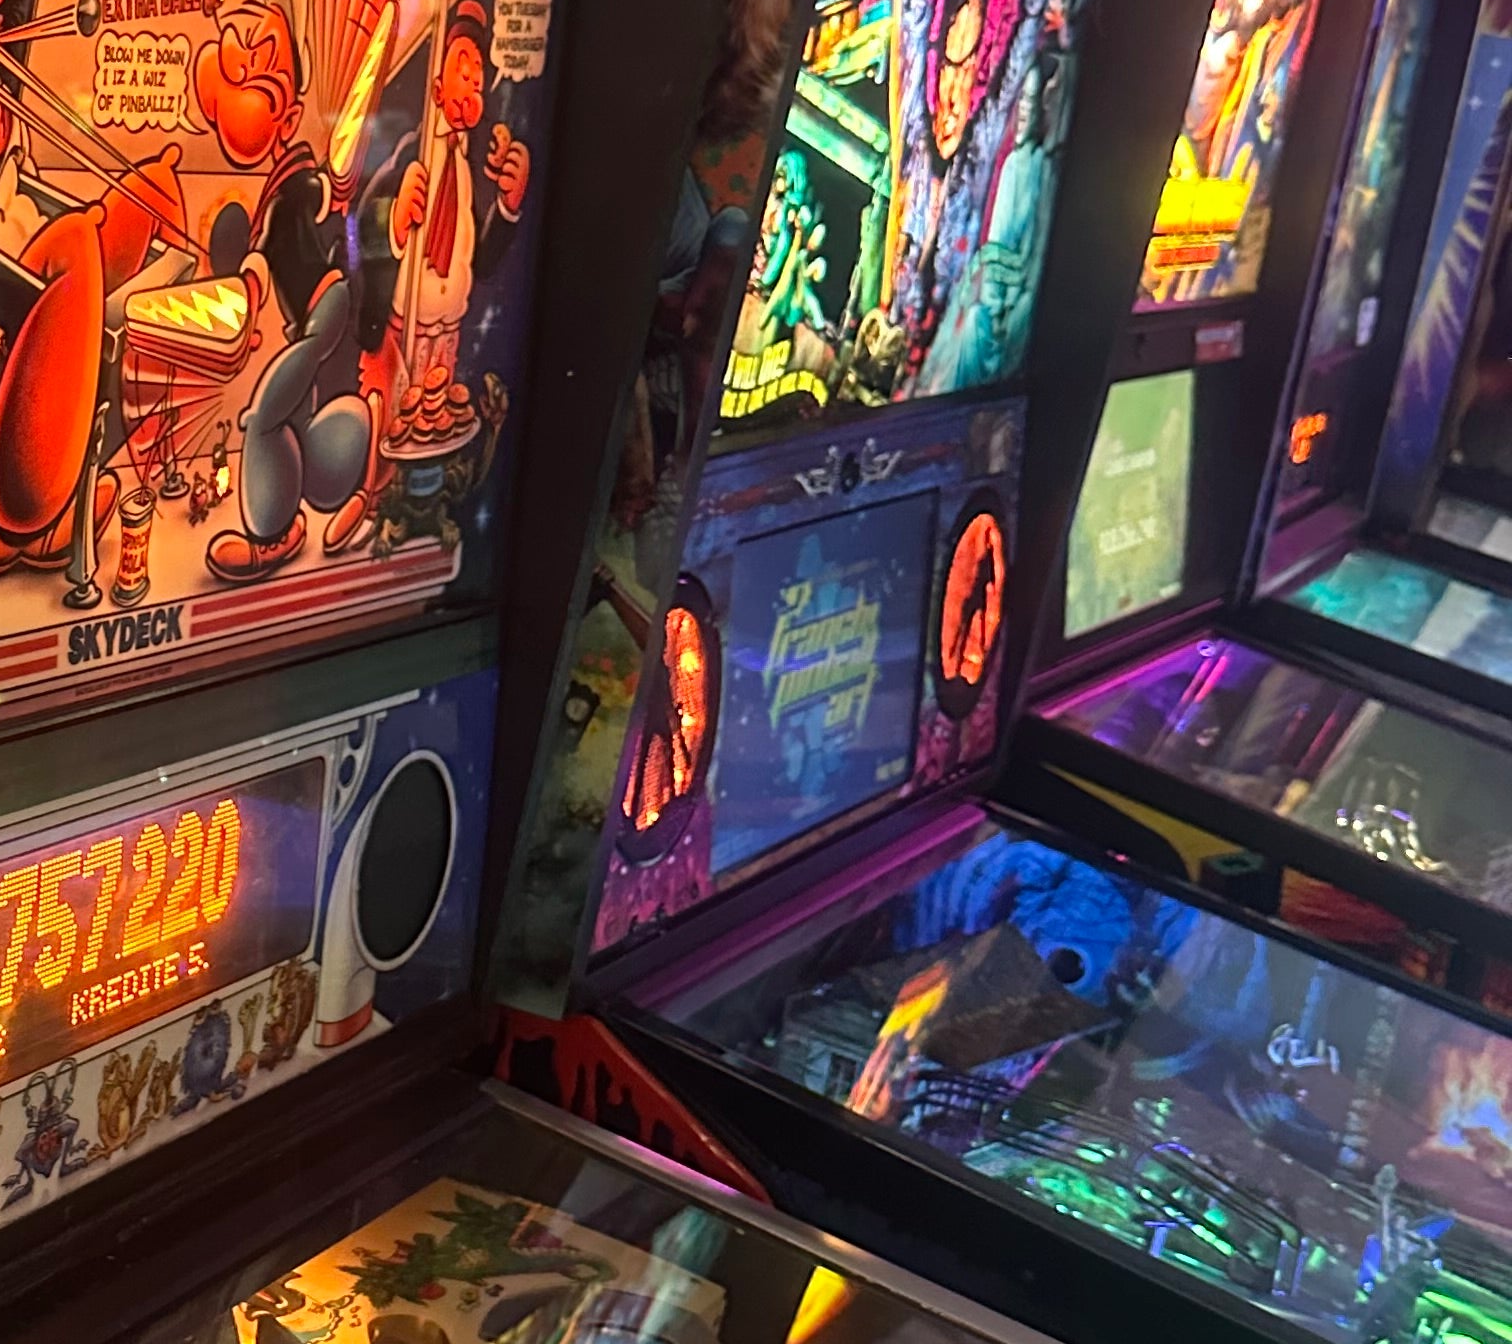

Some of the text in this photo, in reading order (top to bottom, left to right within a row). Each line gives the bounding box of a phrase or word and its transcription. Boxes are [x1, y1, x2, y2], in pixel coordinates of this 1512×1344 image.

[103, 45, 186, 66] BLOW ME DOWN
[113, 70, 125, 85] IZ
[129, 69, 138, 87] A
[144, 70, 166, 87] WIZ
[97, 94, 114, 111] OF
[67, 605, 184, 665] SKYDECK
[71, 951, 181, 1025] KREDITE
